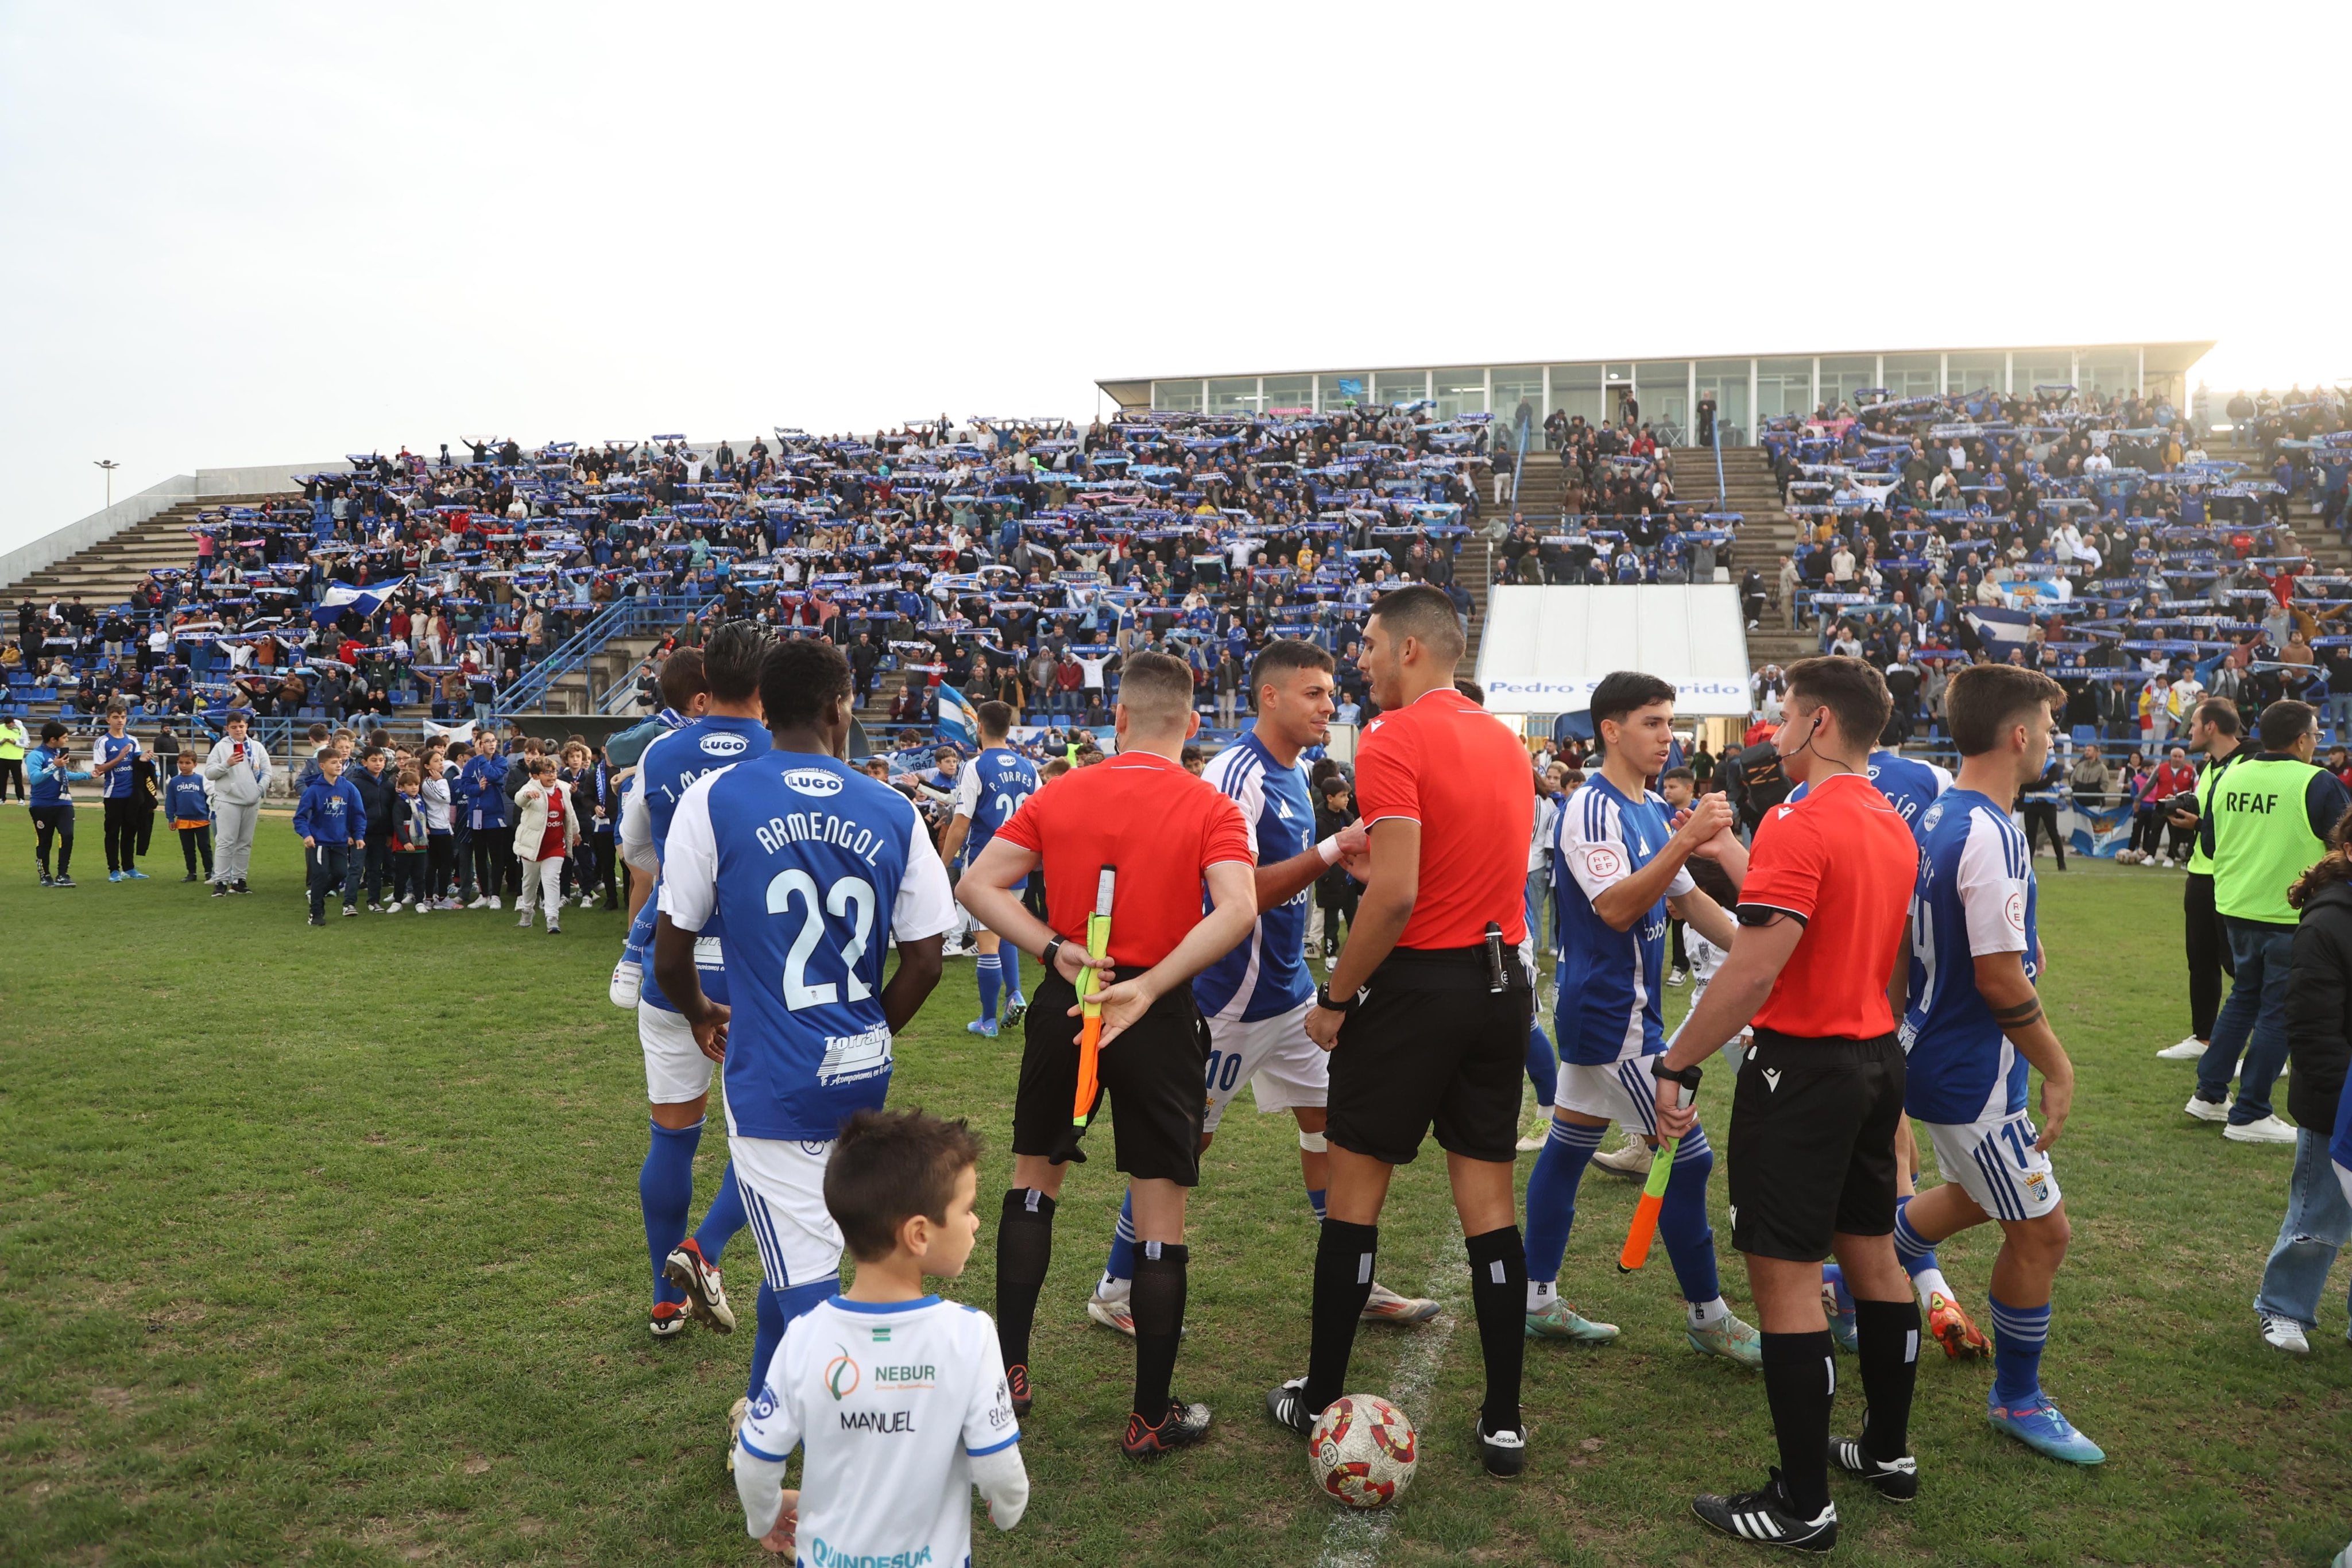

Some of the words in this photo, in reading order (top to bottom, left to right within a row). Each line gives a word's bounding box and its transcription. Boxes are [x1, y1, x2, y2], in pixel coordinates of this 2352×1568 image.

[1281, 606, 1301, 615] XEREZ
[1490, 682, 1575, 693] Pedro
[1679, 682, 1739, 693] rido
[699, 731, 731, 742] DISTRIBUCIONES
[731, 732, 750, 744] CÁRNICAS
[703, 741, 745, 750] LUGO
[911, 760, 932, 771] 1947
[781, 768, 819, 776] DISTRIBUCIONES
[819, 768, 845, 783] CÁRNICAS
[789, 776, 839, 790] LUGO
[989, 783, 1000, 792] P.
[998, 771, 1032, 788] TORRES
[177, 782, 200, 792] CHAPIN
[2226, 792, 2278, 814] RFAF
[1925, 813, 1940, 825] LUGO
[756, 811, 884, 867] ARMENGOL
[765, 869, 876, 1012] 22
[821, 1075, 829, 1086] Te
[829, 1070, 872, 1086] Acompañamos
[1206, 1050, 1242, 1091] 10
[2000, 1117, 2045, 1170] 14
[876, 1365, 936, 1381] NEBUR
[841, 1410, 915, 1434] MANUEL
[813, 1538, 933, 1568] QUINDESUR
